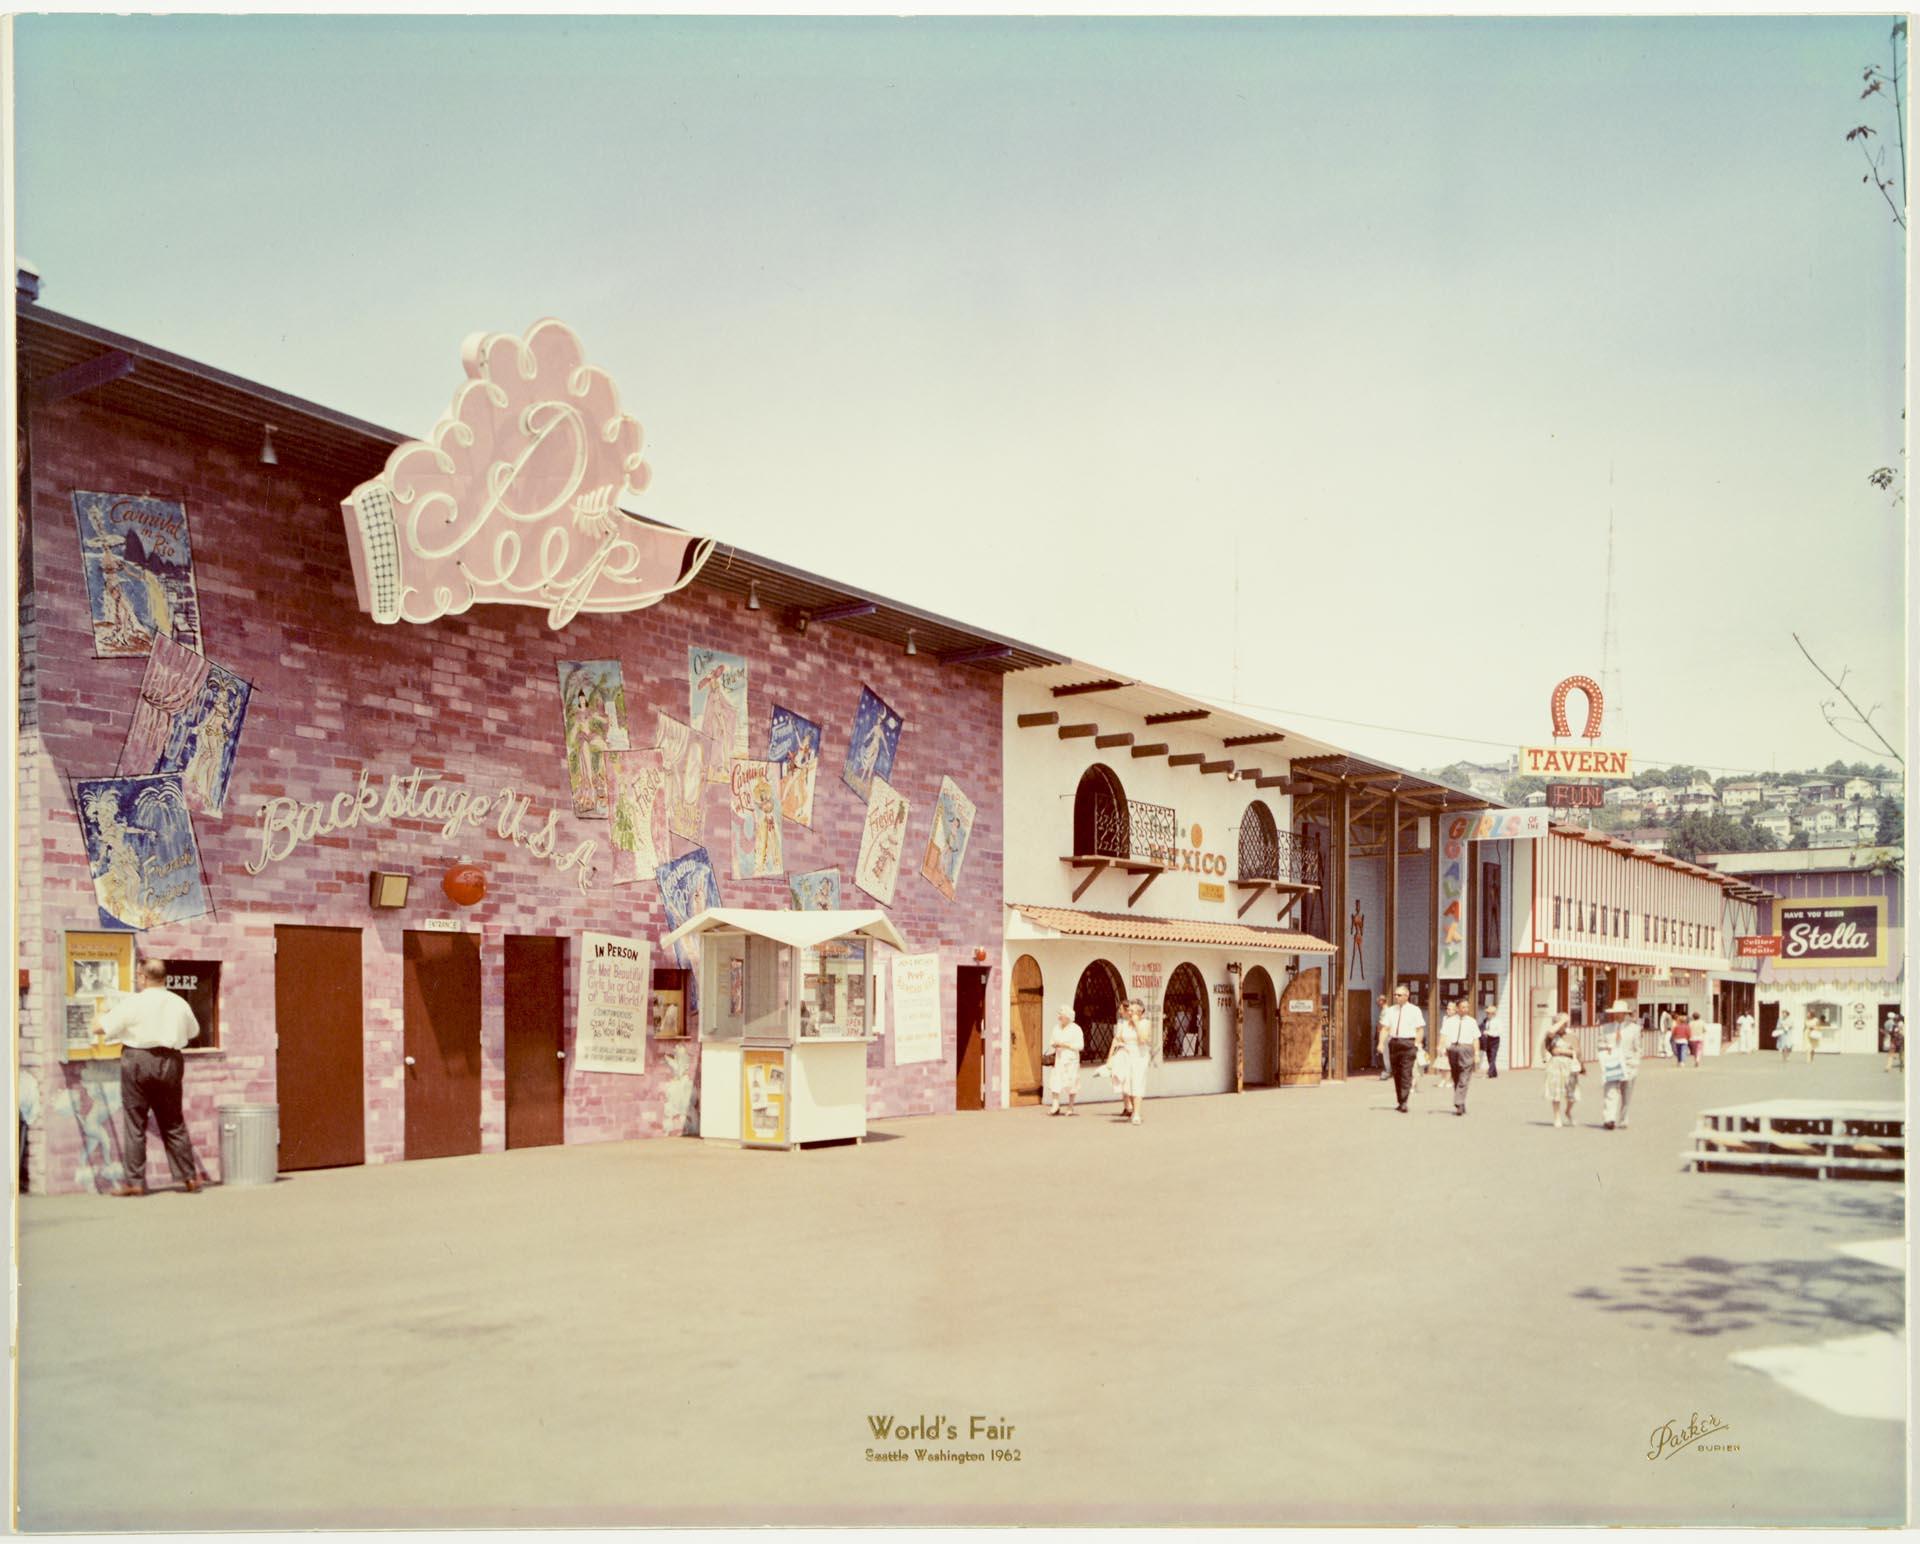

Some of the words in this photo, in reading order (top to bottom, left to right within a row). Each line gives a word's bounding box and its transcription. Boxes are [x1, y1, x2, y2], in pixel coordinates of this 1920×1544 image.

[406, 400, 643, 632] Peep
[153, 532, 176, 557] Rio
[1527, 748, 1628, 773] TAVERN
[1553, 785, 1603, 806] FUN
[244, 767, 492, 876] Backstage
[1449, 815, 1521, 840] GIRLS
[1528, 815, 1538, 823] OF
[1150, 842, 1228, 877] MEXICO
[1443, 840, 1463, 969] GALAXY
[1784, 911, 1804, 919] HAVE
[594, 944, 605, 958] IN
[607, 942, 639, 961] PERSON
[1786, 921, 1870, 957] Stella
[166, 974, 199, 991] PEEP
